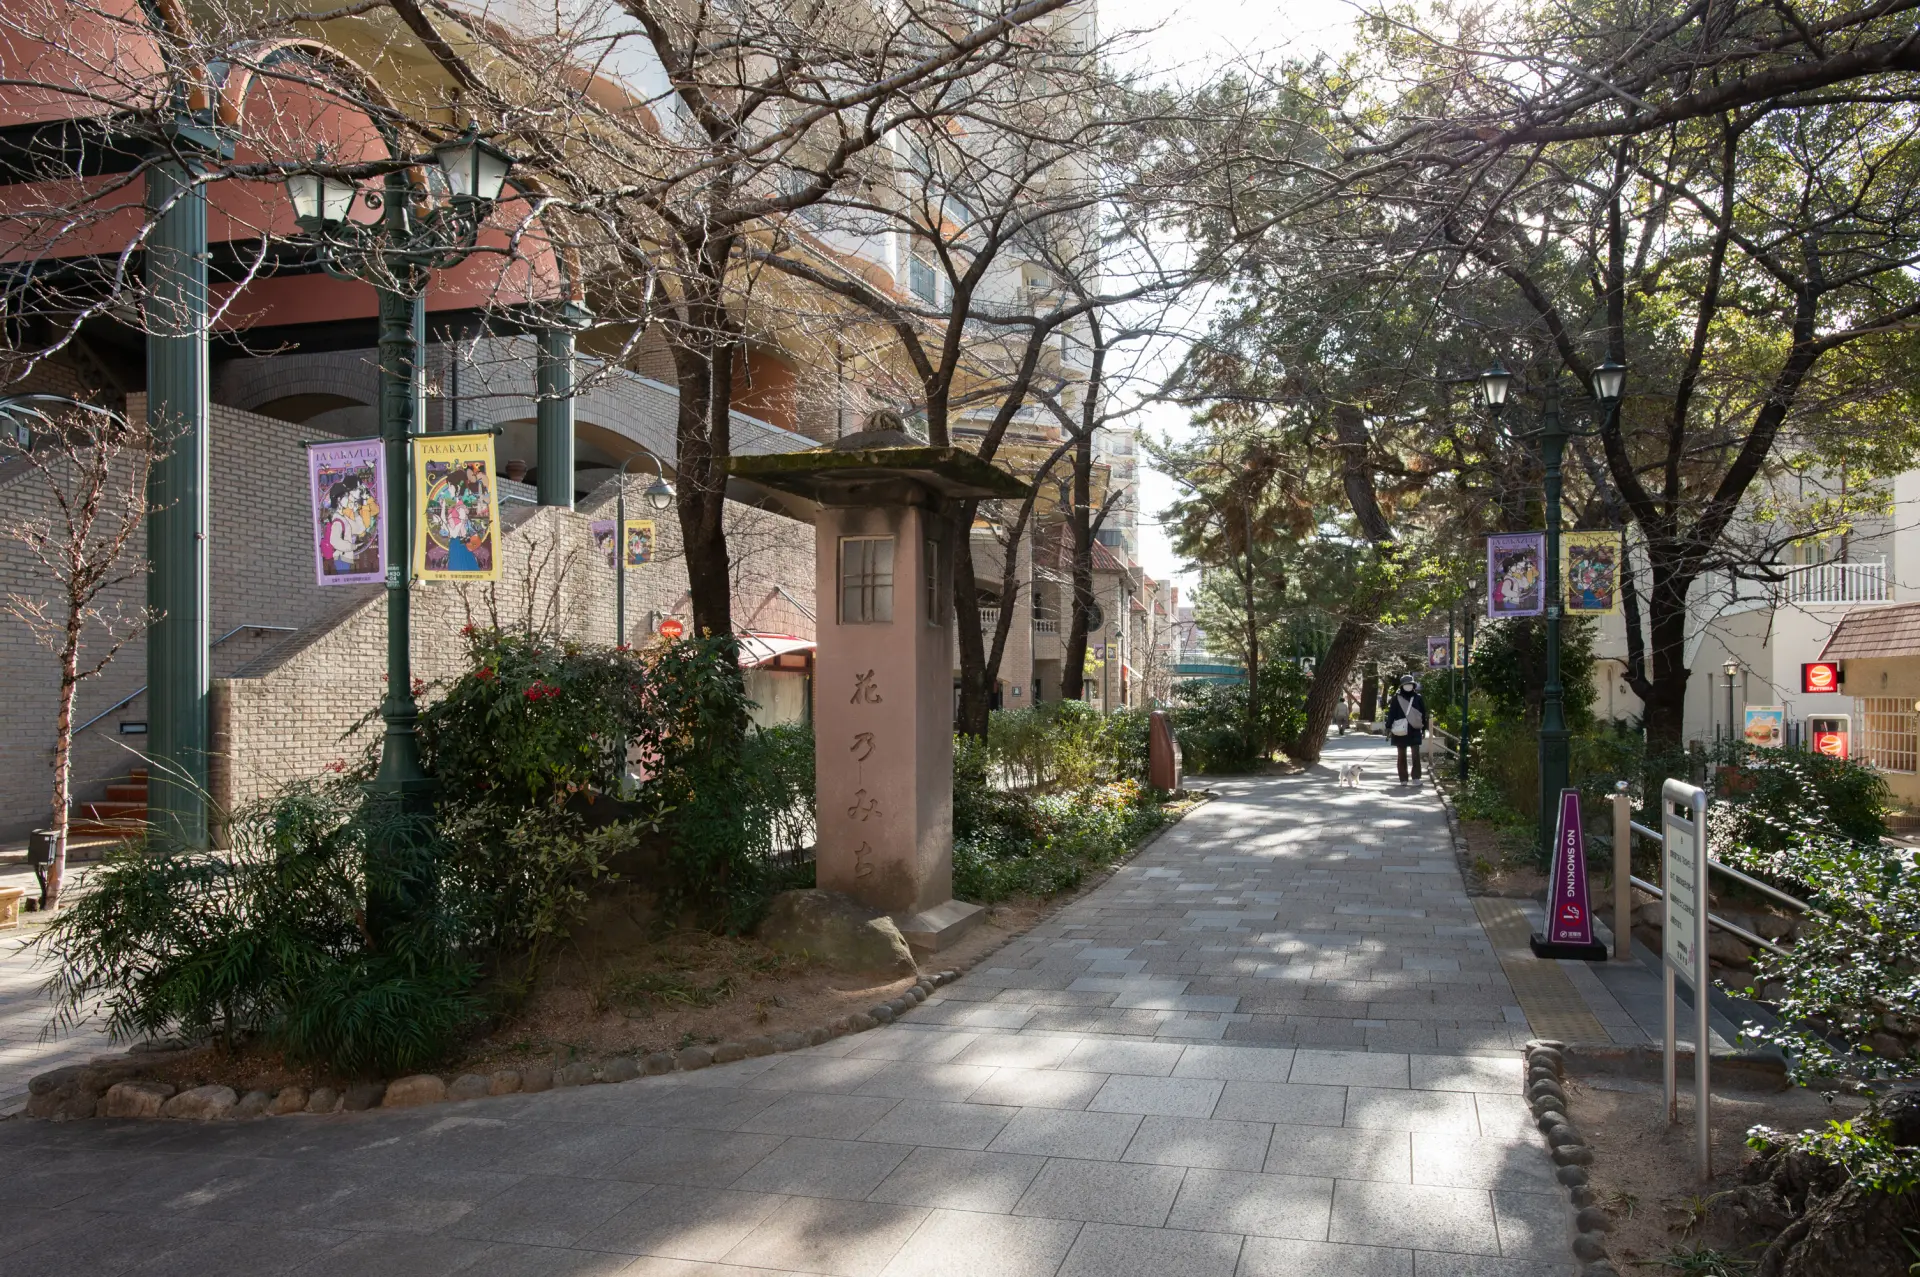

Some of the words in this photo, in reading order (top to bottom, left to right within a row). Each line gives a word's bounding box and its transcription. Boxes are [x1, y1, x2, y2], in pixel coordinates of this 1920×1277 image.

[316, 447, 380, 461] TAKARAZUKA
[421, 443, 488, 454] TAKARAZUKA
[848, 669, 883, 879] 花乃みち
[1567, 829, 1576, 846] NO
[1567, 847, 1576, 898] SMOKING
